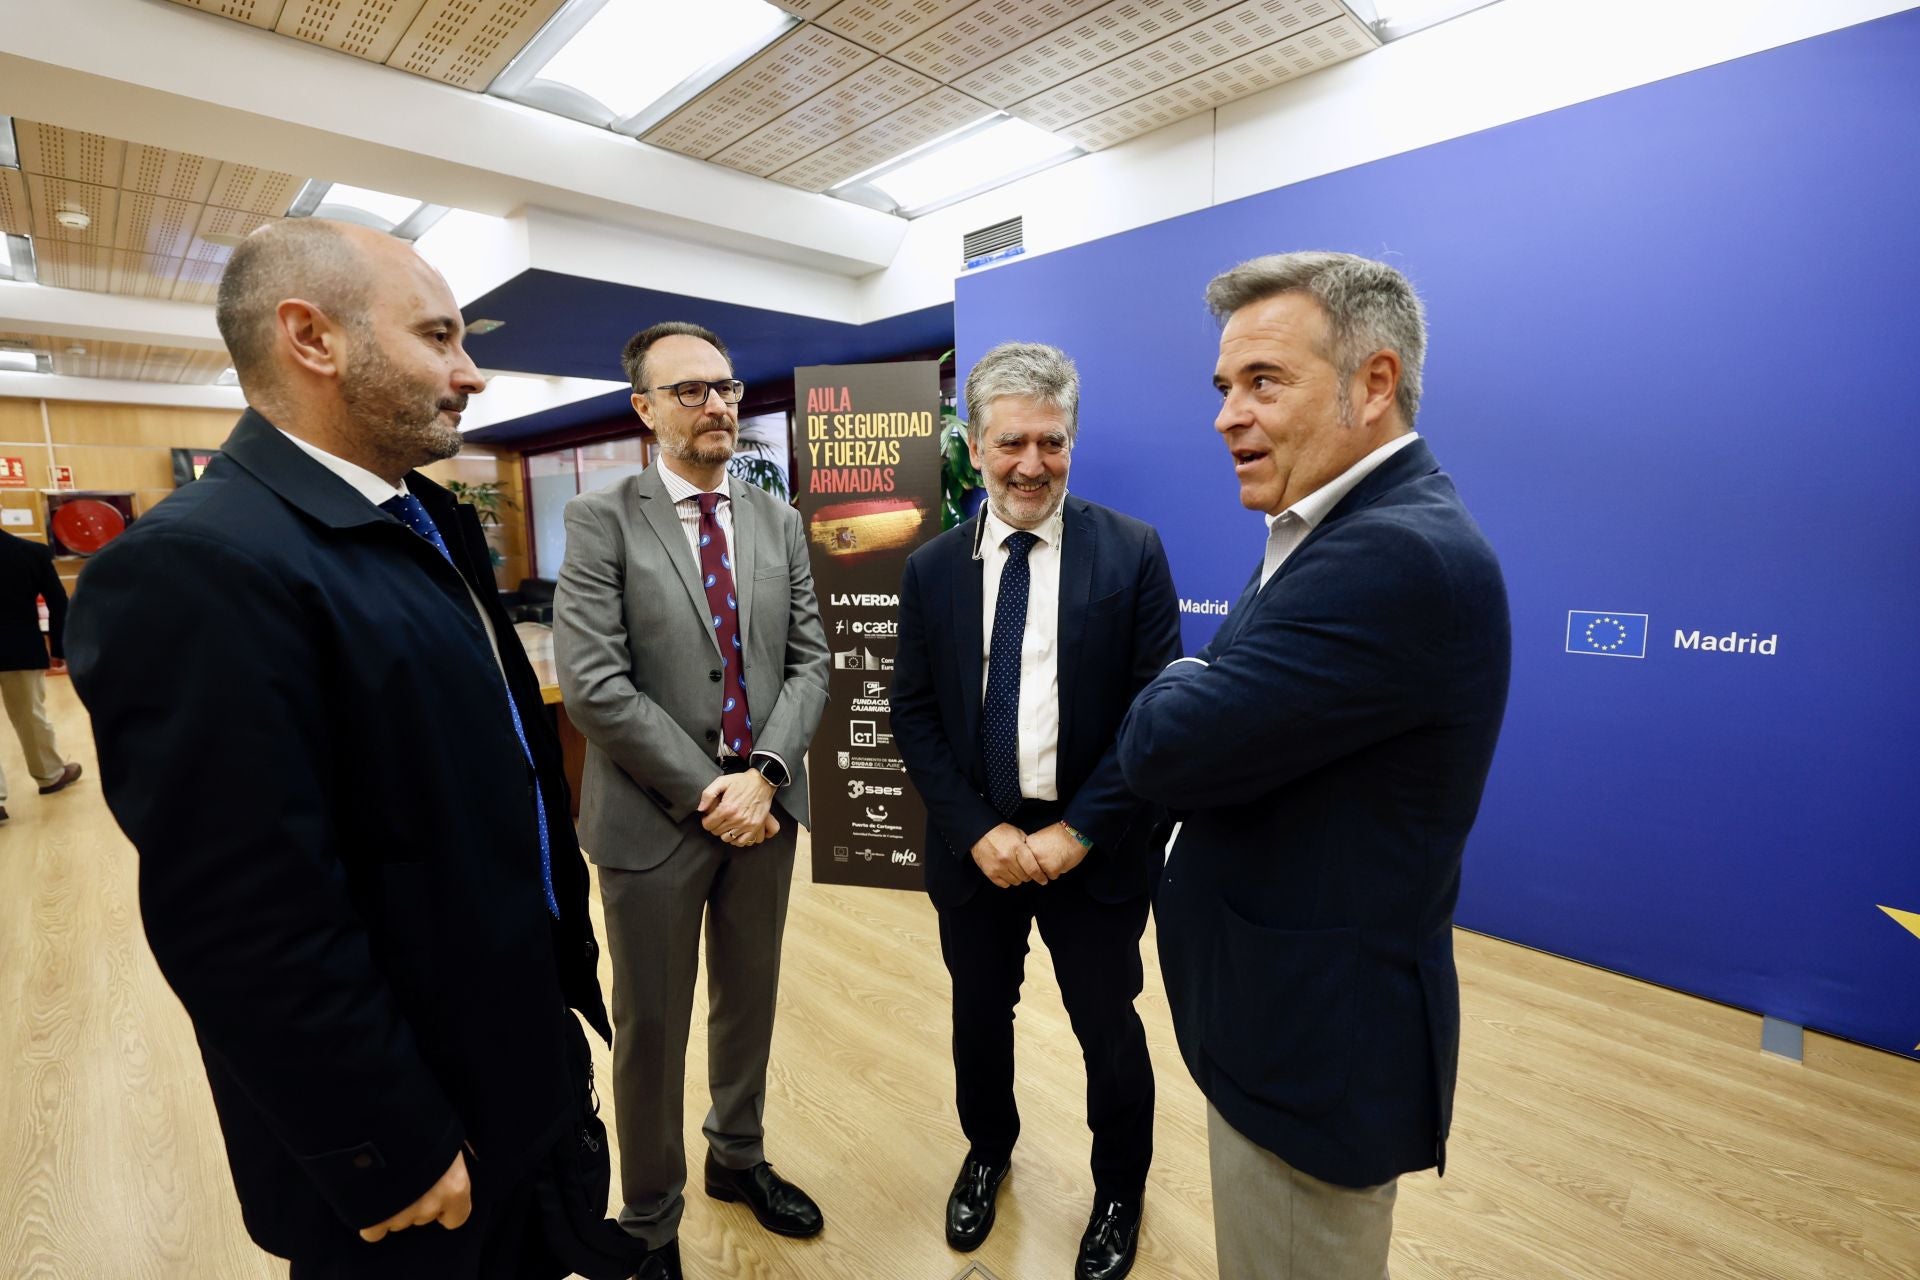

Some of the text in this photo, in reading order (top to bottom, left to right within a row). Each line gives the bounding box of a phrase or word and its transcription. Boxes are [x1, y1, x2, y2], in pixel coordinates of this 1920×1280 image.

[807, 387, 851, 413] AULA
[808, 411, 933, 440] DE SEGURIDAD
[808, 440, 901, 467] Y FUERZAS
[809, 467, 895, 494] ARMADAS
[830, 593, 900, 607] LA VERDA
[1178, 598, 1229, 615] Madrid
[1673, 629, 1778, 656] Madrid
[850, 705, 891, 713] CAJAMURCI
[852, 697, 890, 706] FUNDACIÓ
[854, 732, 873, 743] CT
[864, 785, 903, 796] saes
[891, 848, 917, 866] info
